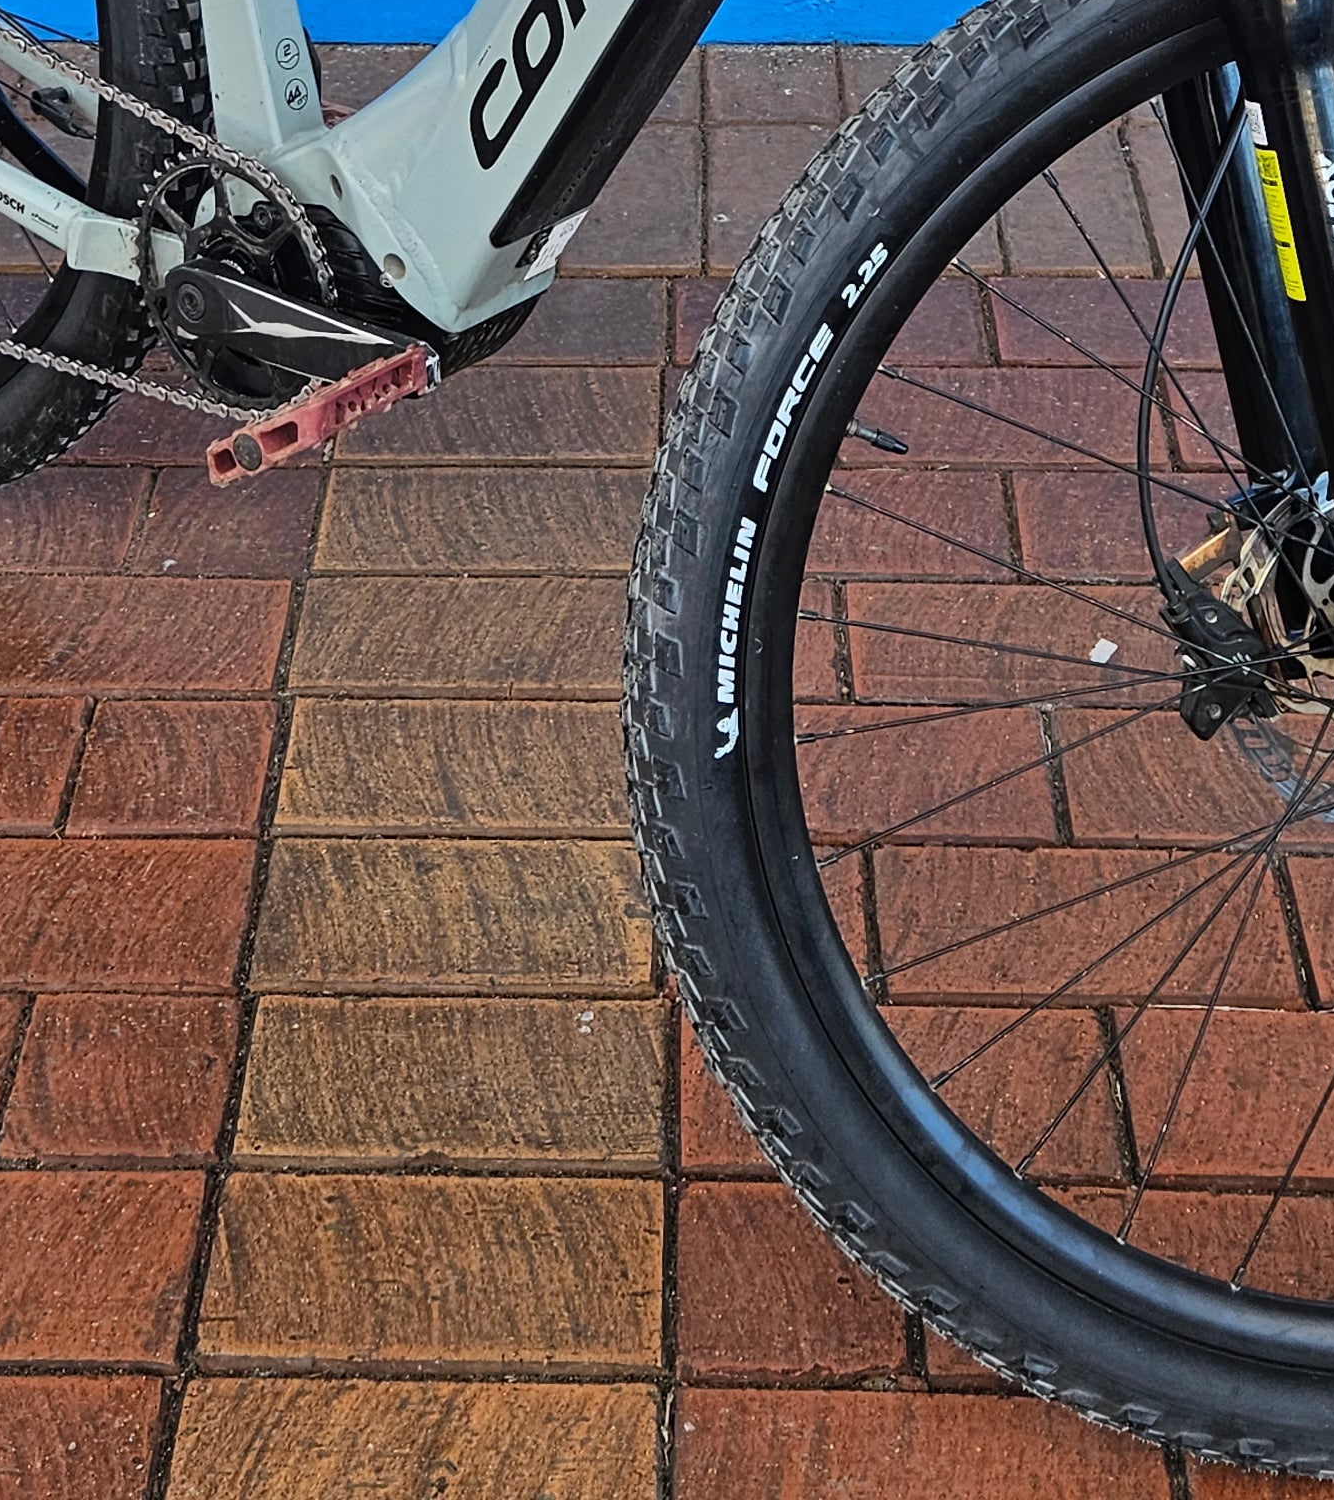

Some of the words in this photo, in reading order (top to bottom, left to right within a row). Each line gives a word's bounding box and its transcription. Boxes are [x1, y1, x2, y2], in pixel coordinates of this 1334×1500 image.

[717, 516, 757, 704] MICHELIN
[752, 323, 834, 492] FORCE
[841, 241, 890, 308] 2.25
